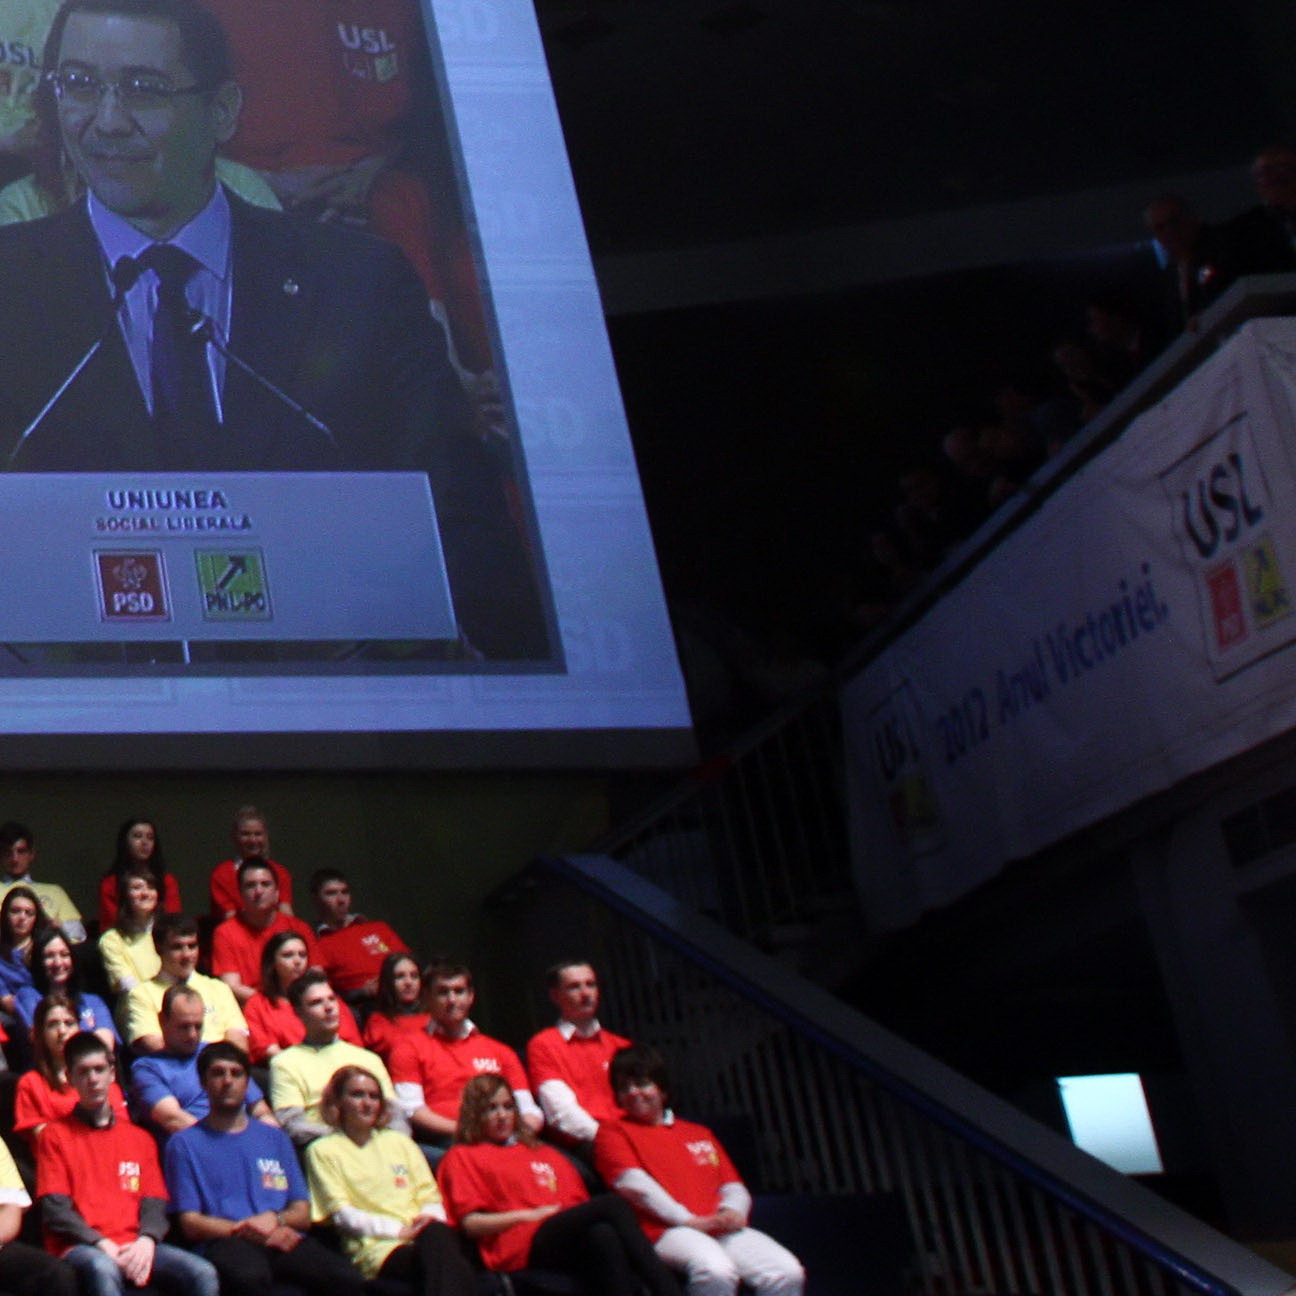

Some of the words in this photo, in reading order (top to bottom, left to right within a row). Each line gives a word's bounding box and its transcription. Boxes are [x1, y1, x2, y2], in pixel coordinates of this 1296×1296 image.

[337, 23, 396, 54] USL
[108, 490, 227, 509] UNIUNEA
[1182, 453, 1263, 559] USL
[113, 592, 154, 613] PSD
